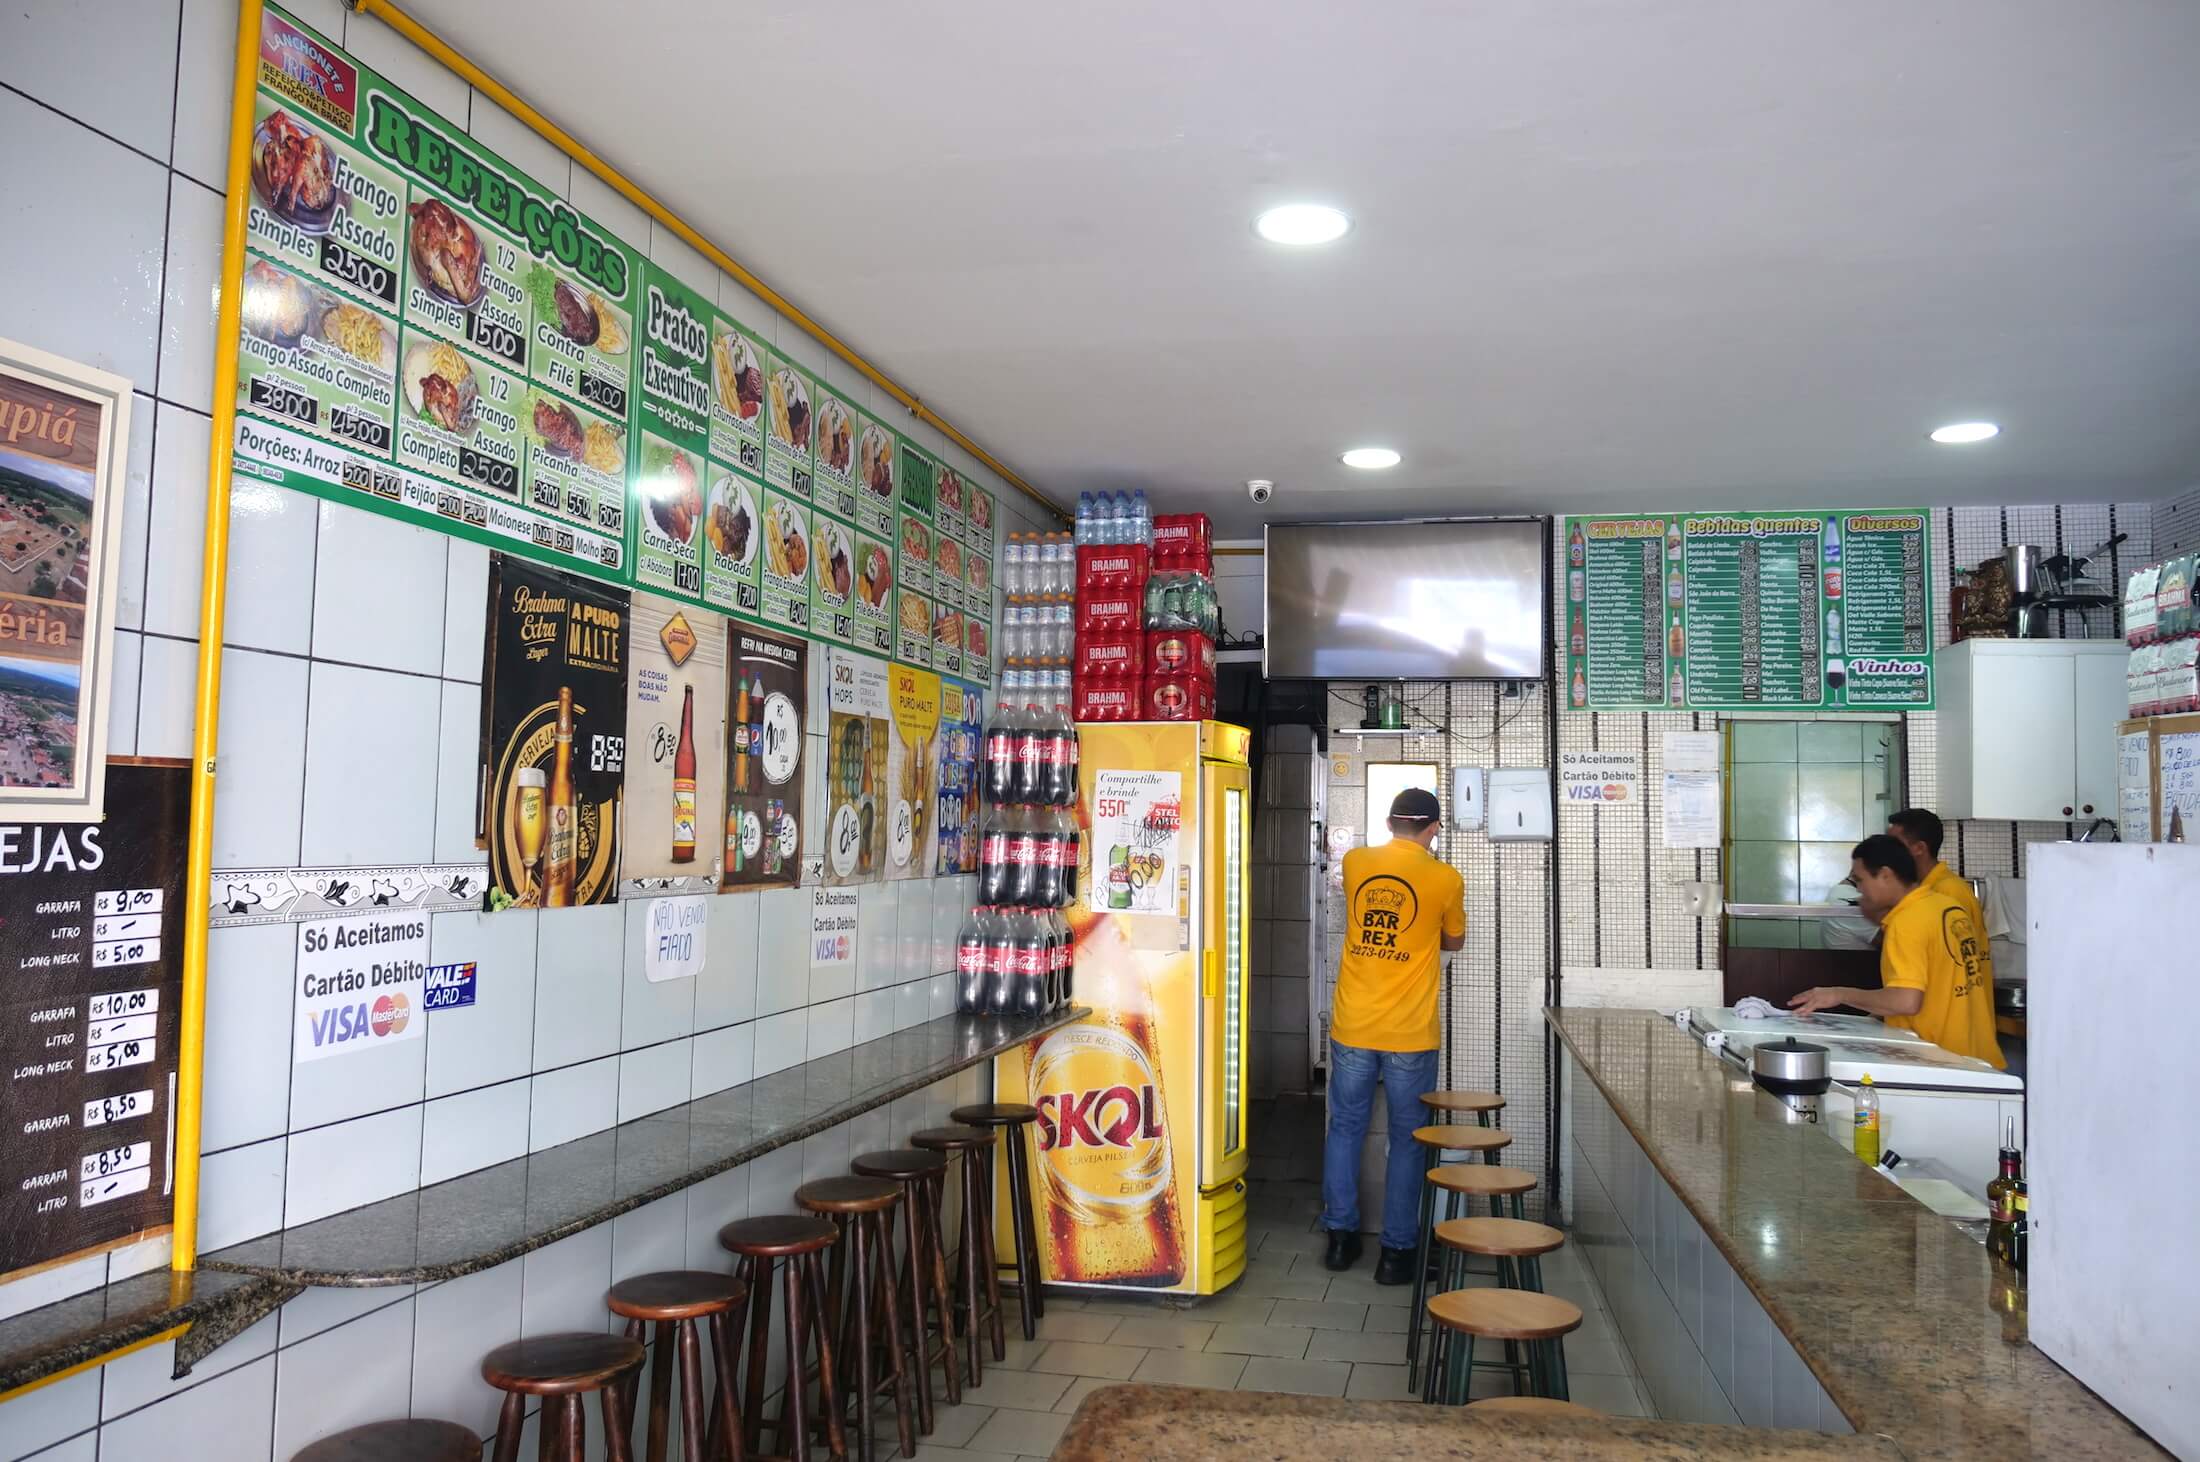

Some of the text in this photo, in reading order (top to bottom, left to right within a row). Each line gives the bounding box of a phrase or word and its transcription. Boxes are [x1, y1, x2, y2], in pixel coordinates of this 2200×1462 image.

[265, 32, 345, 94] LANCHONETE
[263, 72, 350, 133] FRANGO NA BRASA
[334, 157, 398, 217] Frango
[369, 94, 627, 297] REFEIÇÕES
[248, 208, 316, 258] Simples
[330, 206, 395, 262] Assado
[496, 245, 516, 272] 1/2
[481, 266, 523, 304] Frango
[410, 288, 462, 329] Simples
[480, 298, 523, 333] Assado
[650, 291, 706, 358] Pratos
[537, 324, 586, 363] Contra
[240, 331, 391, 406] Frango Assado Completo
[548, 361, 575, 388] Filé
[279, 378, 306, 393] pessoas
[489, 375, 508, 401] 1/2
[644, 351, 709, 412] Executivos
[357, 409, 381, 422] pessoas
[474, 398, 516, 432] Frango
[712, 403, 761, 441] Churrasquinho
[239, 425, 302, 464] Porções:
[302, 447, 340, 476] Arroz
[401, 432, 458, 469] Completo
[473, 431, 517, 461] Assado
[532, 446, 579, 478] Picanha
[404, 479, 437, 507] Feijão
[488, 506, 532, 536] Maionese
[1587, 521, 1665, 538] CERVEJAS
[1686, 519, 1821, 538] Bebidas Quentes
[1850, 516, 1919, 530] Diversos
[1152, 526, 1189, 540] BRAHMA
[575, 537, 600, 560] Molho
[643, 529, 696, 560] Carne Seca
[647, 557, 673, 577] Abóbora
[714, 552, 752, 578] Rabada
[1091, 559, 1129, 572] BRAHMA
[763, 568, 783, 590] Frango
[511, 585, 567, 614] Brahma
[1090, 602, 1128, 616] BRAHMA
[571, 602, 620, 630] A PURO
[520, 614, 558, 641] Extra
[569, 622, 620, 663] MALTE
[740, 637, 755, 651] REFRI
[755, 642, 764, 653] NA
[1089, 646, 1127, 660] BRAHMA
[638, 669, 668, 682] AS COISAS
[834, 664, 854, 685] SKOL
[1851, 659, 1922, 673] Vinhos
[638, 680, 668, 693] BOAS NÃO
[899, 676, 915, 694] SKOL
[834, 688, 853, 704] HOPS
[899, 695, 915, 710] PURO
[1088, 691, 1126, 705] BRAHMA
[1562, 754, 1635, 764] Só Aceitamos
[1100, 773, 1163, 787] Compartilhe
[1562, 770, 1636, 781] Cartão Débito
[1107, 786, 1140, 798] brinde
[1568, 784, 1602, 800] VISA
[1099, 799, 1125, 818] 550
[35, 901, 81, 914] GARRAFA
[97, 898, 109, 909] R$
[815, 891, 857, 906] Só Aceitamos
[653, 900, 705, 932] NÃO VENDO
[814, 915, 857, 932] Cartão Débito
[1362, 912, 1400, 930] BAR
[51, 926, 81, 939] LITRO
[96, 923, 108, 935] R$
[304, 921, 424, 953] Só Aceitamos
[1361, 929, 1398, 948] REX
[95, 950, 107, 961] R$
[658, 932, 693, 962] FIADO
[816, 938, 836, 961] VISA
[20, 953, 81, 969] LONG NECK
[303, 959, 424, 999] Cartão Débito
[425, 966, 465, 990] VALE
[424, 987, 460, 1008] CARD
[30, 1006, 76, 1023] GARRAFA
[91, 1002, 104, 1015] R$
[90, 1027, 102, 1041] R$
[306, 1002, 370, 1047] VISA
[45, 1033, 75, 1048] LITRO
[14, 1059, 74, 1079] LONG NECK
[89, 1053, 101, 1066] R$
[24, 1113, 70, 1133] GARRAFA
[87, 1107, 99, 1121] R$
[1036, 1085, 1163, 1151] SKOL
[84, 1161, 96, 1175] R$
[22, 1170, 68, 1190] GARRAFA
[83, 1186, 95, 1200] R$
[37, 1195, 68, 1213] LITRO
